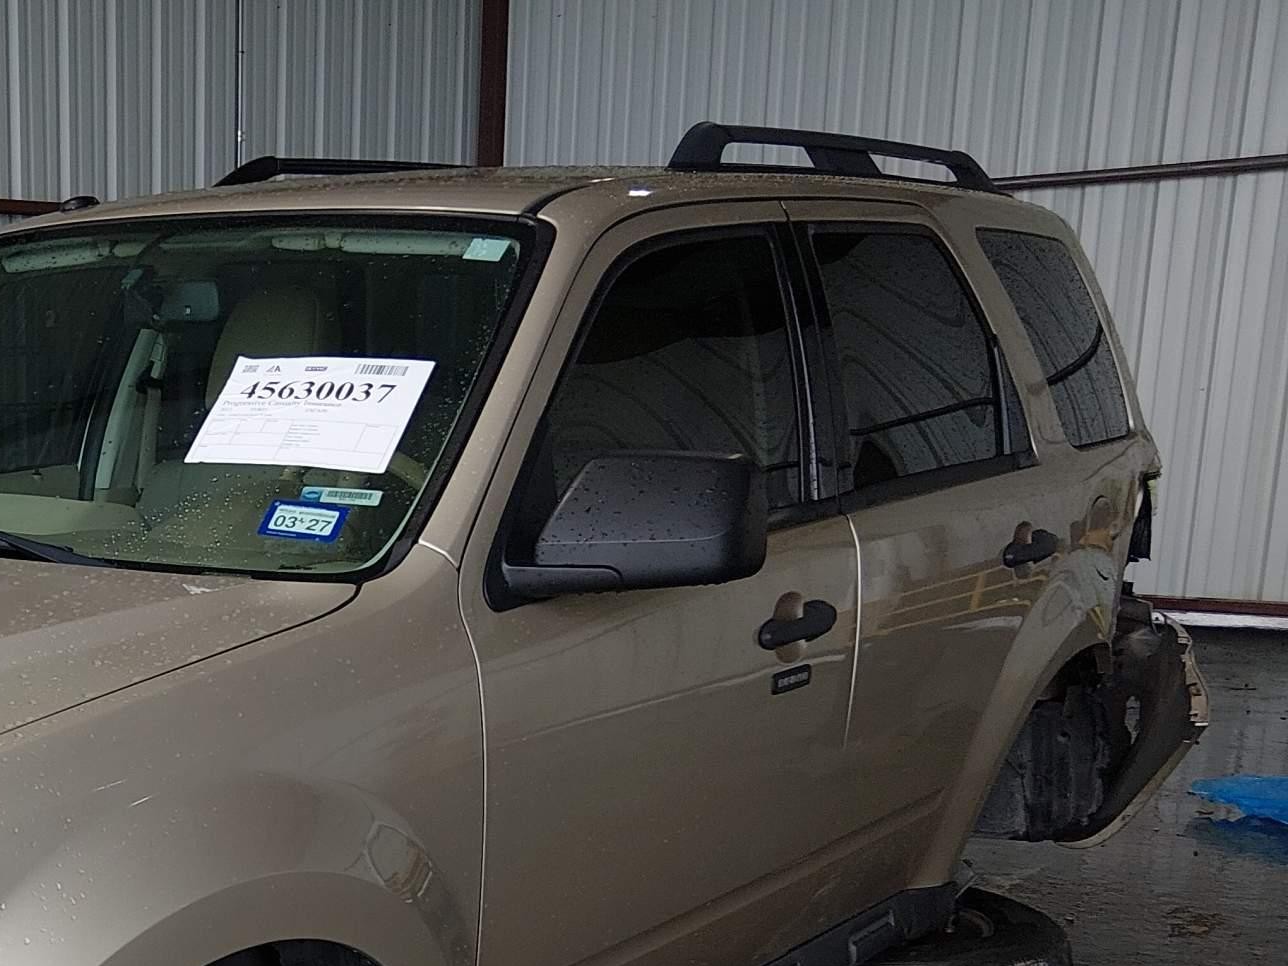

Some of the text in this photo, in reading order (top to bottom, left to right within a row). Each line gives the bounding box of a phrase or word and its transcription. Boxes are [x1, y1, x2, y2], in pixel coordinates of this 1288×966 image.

[240, 380, 396, 403] 45630037
[274, 515, 332, 532] 03 27
